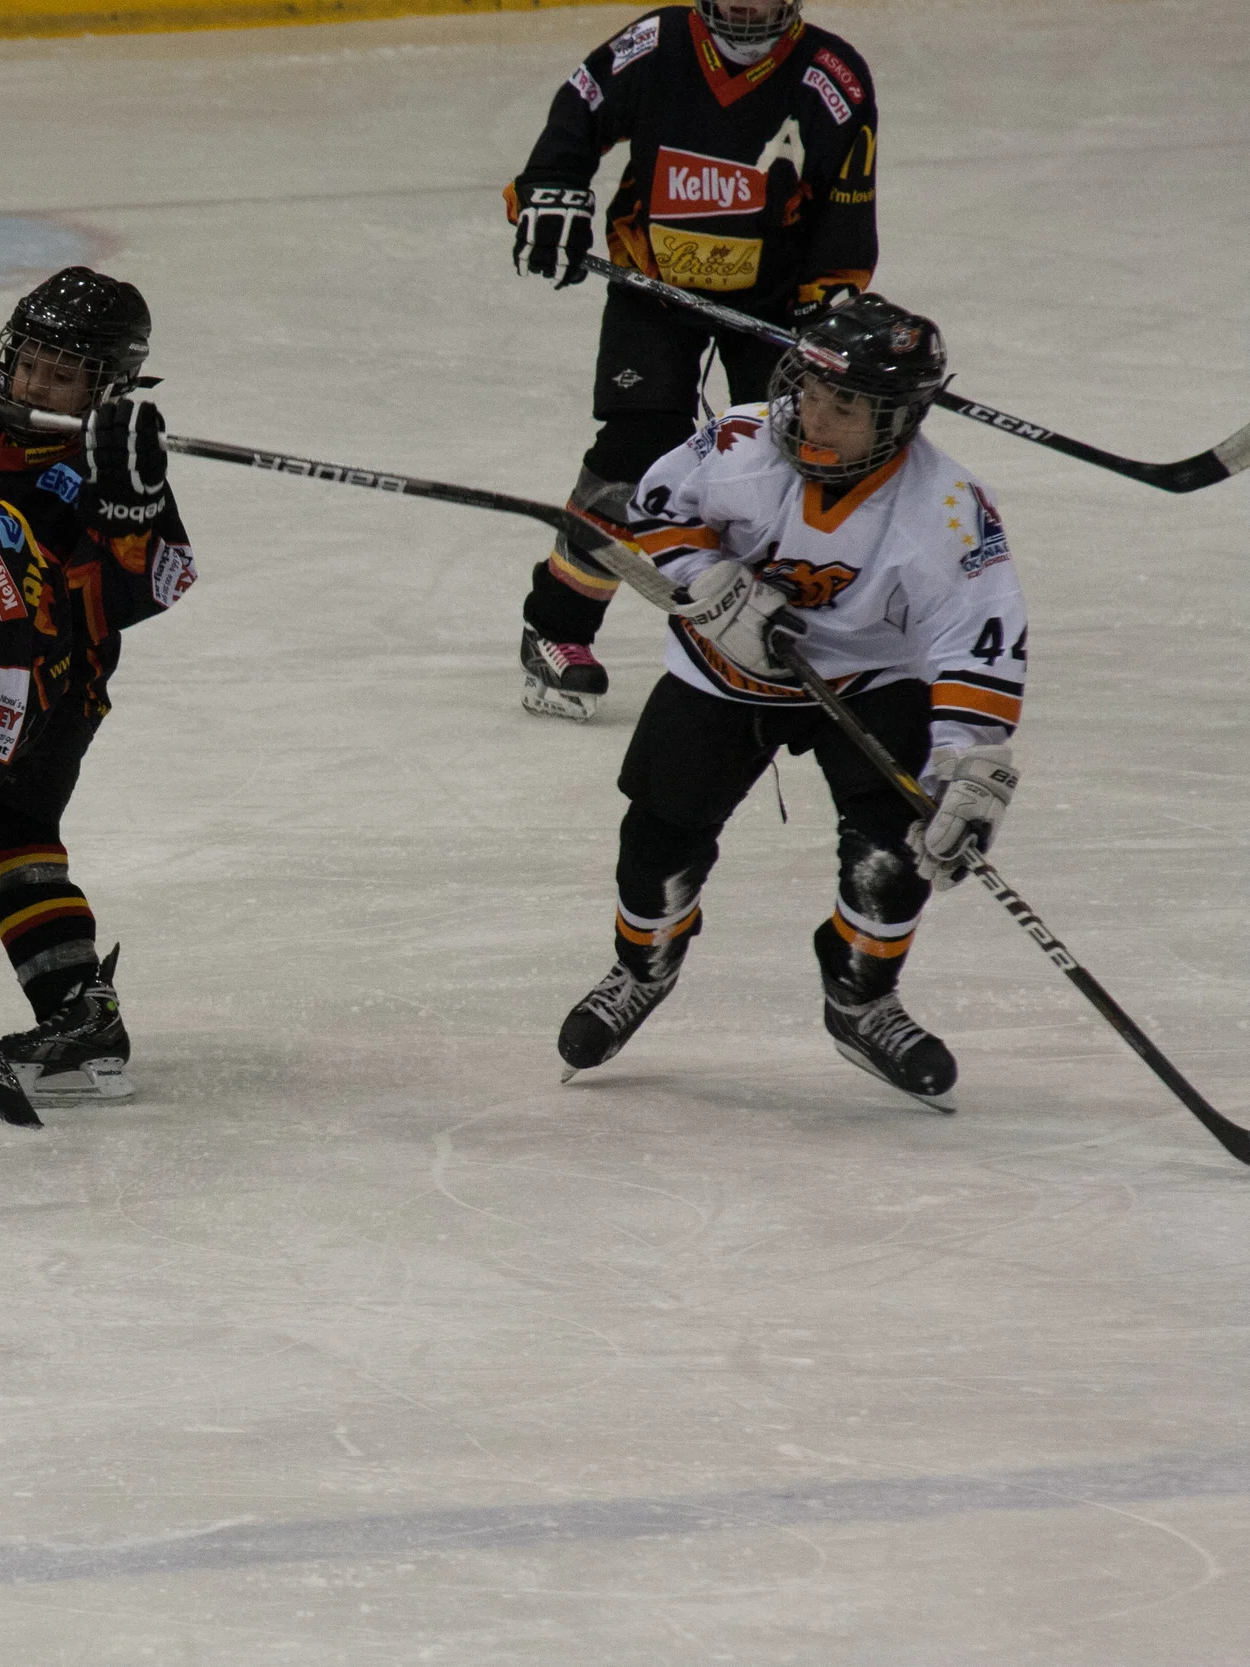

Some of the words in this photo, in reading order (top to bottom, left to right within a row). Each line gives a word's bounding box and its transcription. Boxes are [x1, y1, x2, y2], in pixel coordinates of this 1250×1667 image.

[819, 52, 851, 84] ASKO
[807, 70, 849, 121] RICOH
[668, 166, 751, 208] Kelly's
[794, 302, 817, 316] CCM
[967, 402, 1050, 442] CCM
